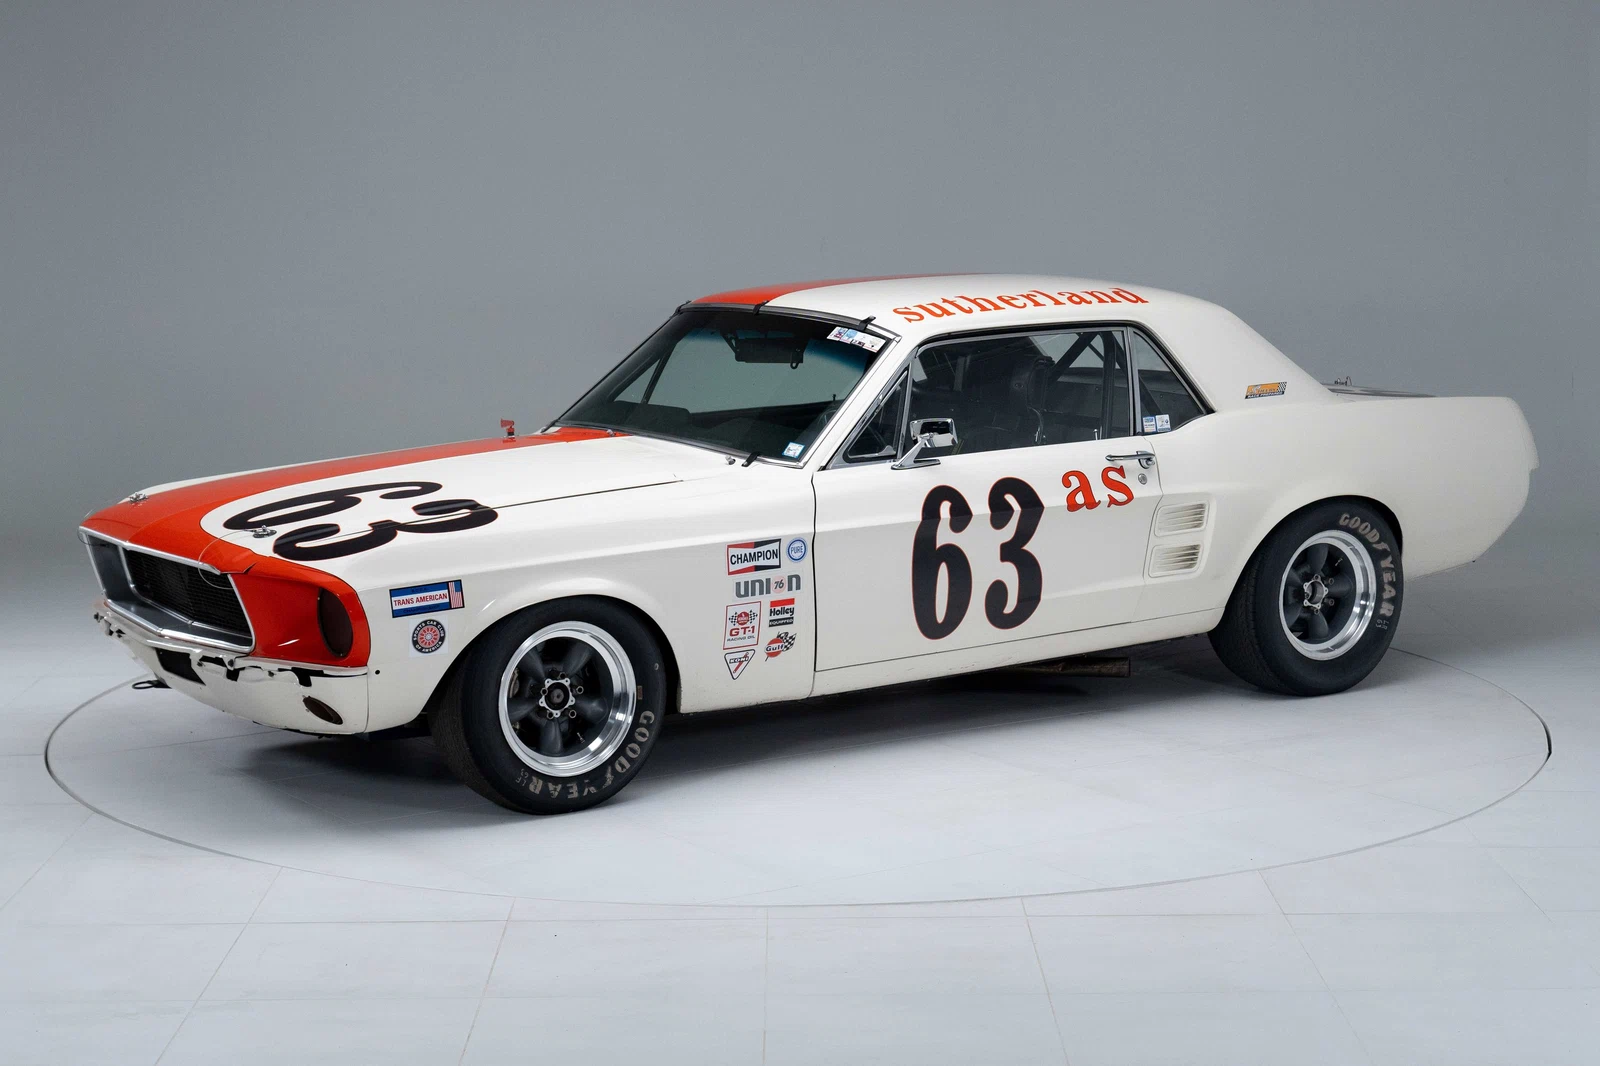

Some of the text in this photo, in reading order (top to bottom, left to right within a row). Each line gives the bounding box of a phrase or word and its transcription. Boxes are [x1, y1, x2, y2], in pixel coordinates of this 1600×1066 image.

[893, 287, 1149, 323] sutherland
[1062, 465, 1134, 512] as
[223, 481, 499, 561] 63
[730, 548, 778, 565] CHAMPION
[790, 545, 803, 554] PURE
[911, 477, 1045, 640] 63
[774, 579, 784, 590] 76
[393, 592, 448, 607] TRANS AMERICAN
[769, 606, 795, 617] Holley
[413, 622, 426, 641] SPORTS
[437, 624, 445, 638] CLUB
[729, 625, 756, 637] GT-1
[422, 641, 442, 652] AMERICA
[765, 643, 785, 652] Gulf
